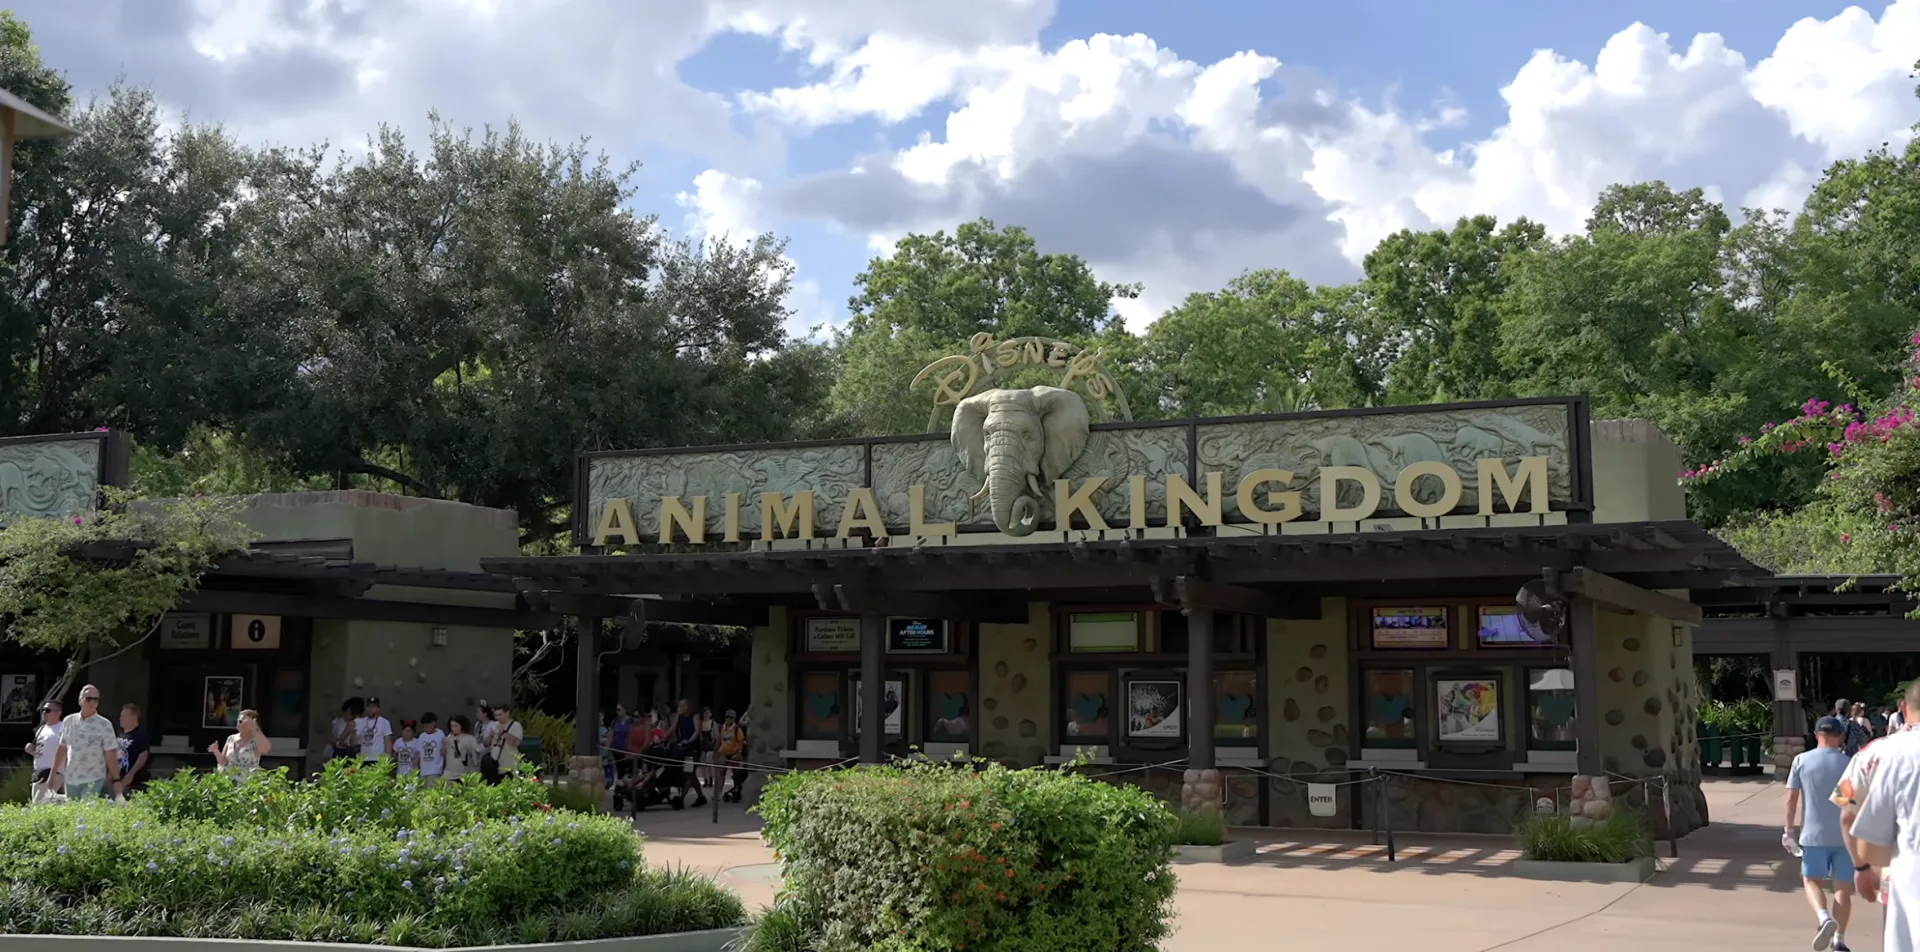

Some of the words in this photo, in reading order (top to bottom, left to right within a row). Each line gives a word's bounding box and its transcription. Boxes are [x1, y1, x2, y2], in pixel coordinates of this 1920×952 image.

[593, 485, 958, 545] ANIMAL
[1053, 455, 1552, 531] KINGDOM
[176, 620, 196, 629] Guest
[1310, 795, 1333, 803] ENTER
